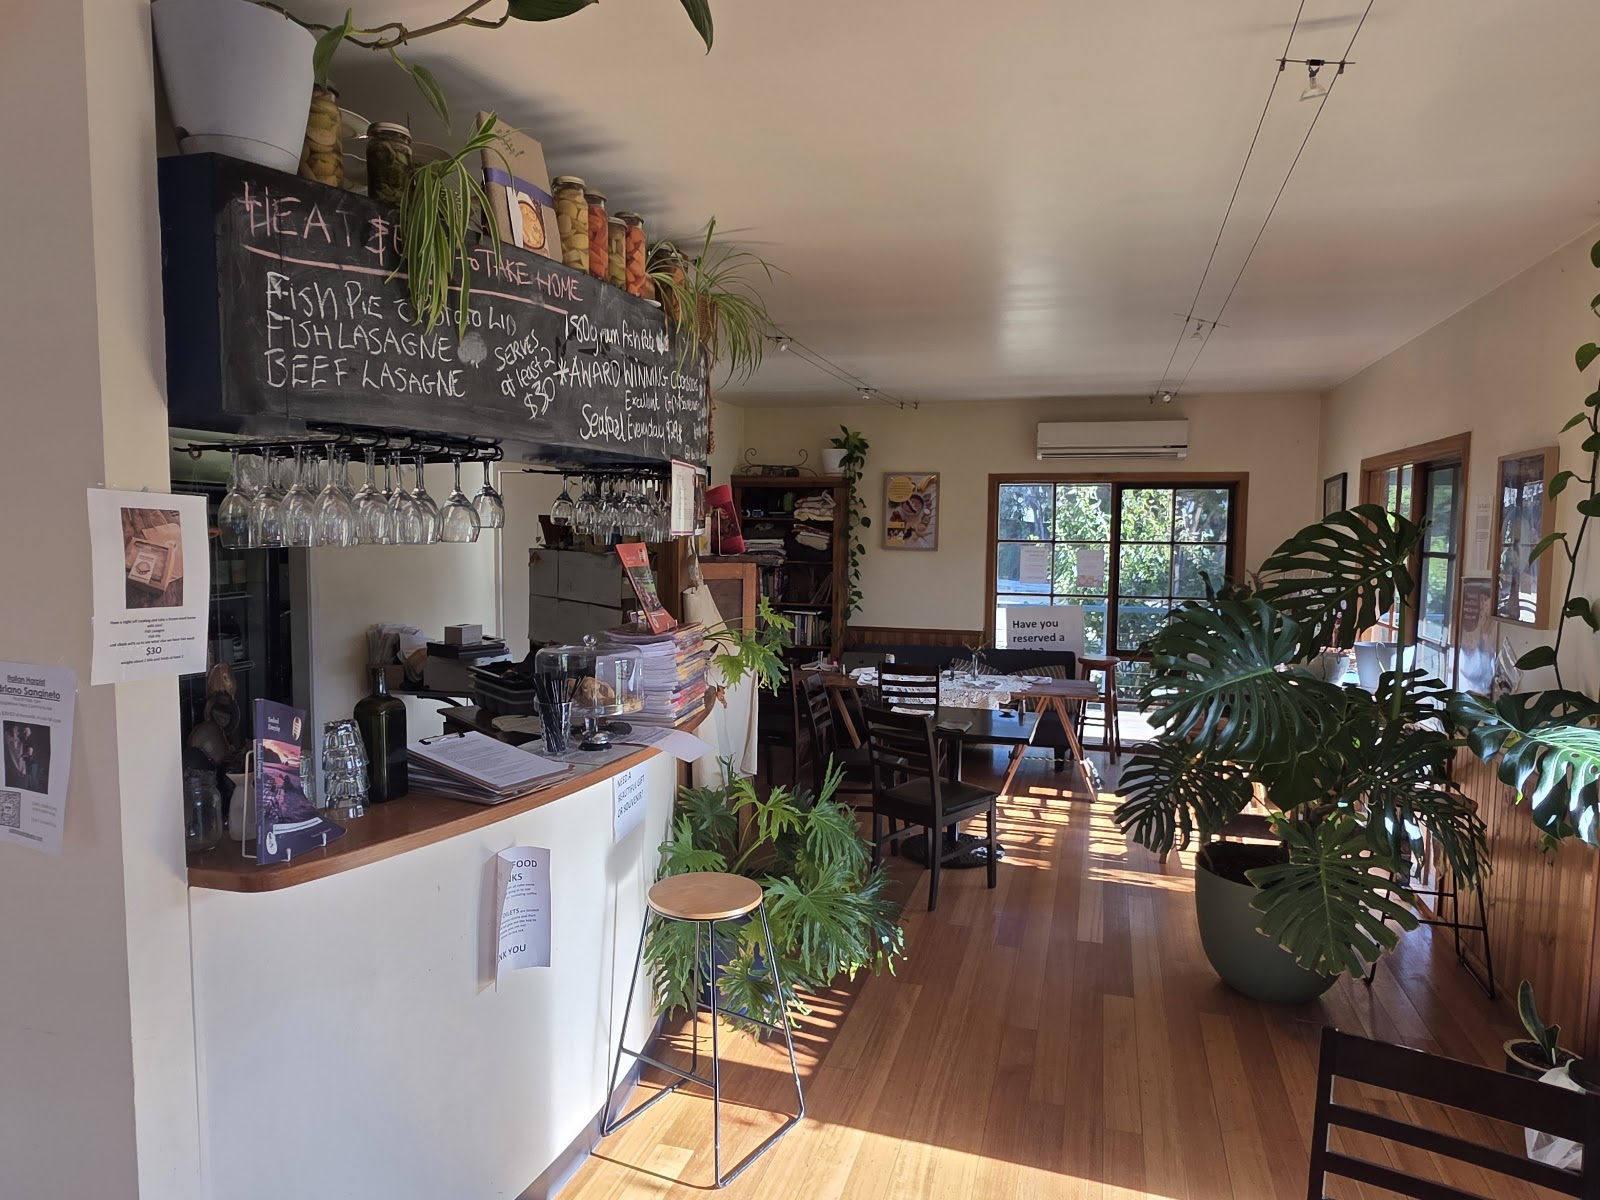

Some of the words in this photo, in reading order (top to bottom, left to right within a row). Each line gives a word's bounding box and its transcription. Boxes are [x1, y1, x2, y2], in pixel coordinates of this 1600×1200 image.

[237, 181, 357, 248] HEAT
[474, 248, 533, 285] TAKE
[535, 270, 583, 302] HOME
[266, 309, 334, 350] FISH
[338, 321, 454, 362] LASAGNE
[488, 306, 517, 336] LID
[494, 328, 540, 372] SERVES
[541, 346, 555, 368] 2
[264, 348, 348, 388] BEEF
[361, 358, 466, 398] LASAGNE
[523, 375, 556, 419] $30
[1012, 620, 1037, 629] Have
[1039, 620, 1059, 630] you
[1012, 633, 1056, 643] reserved
[1058, 634, 1065, 642] a
[145, 646, 162, 656] $30
[24, 686, 61, 700] Sangineto
[508, 943, 527, 956] YOU
